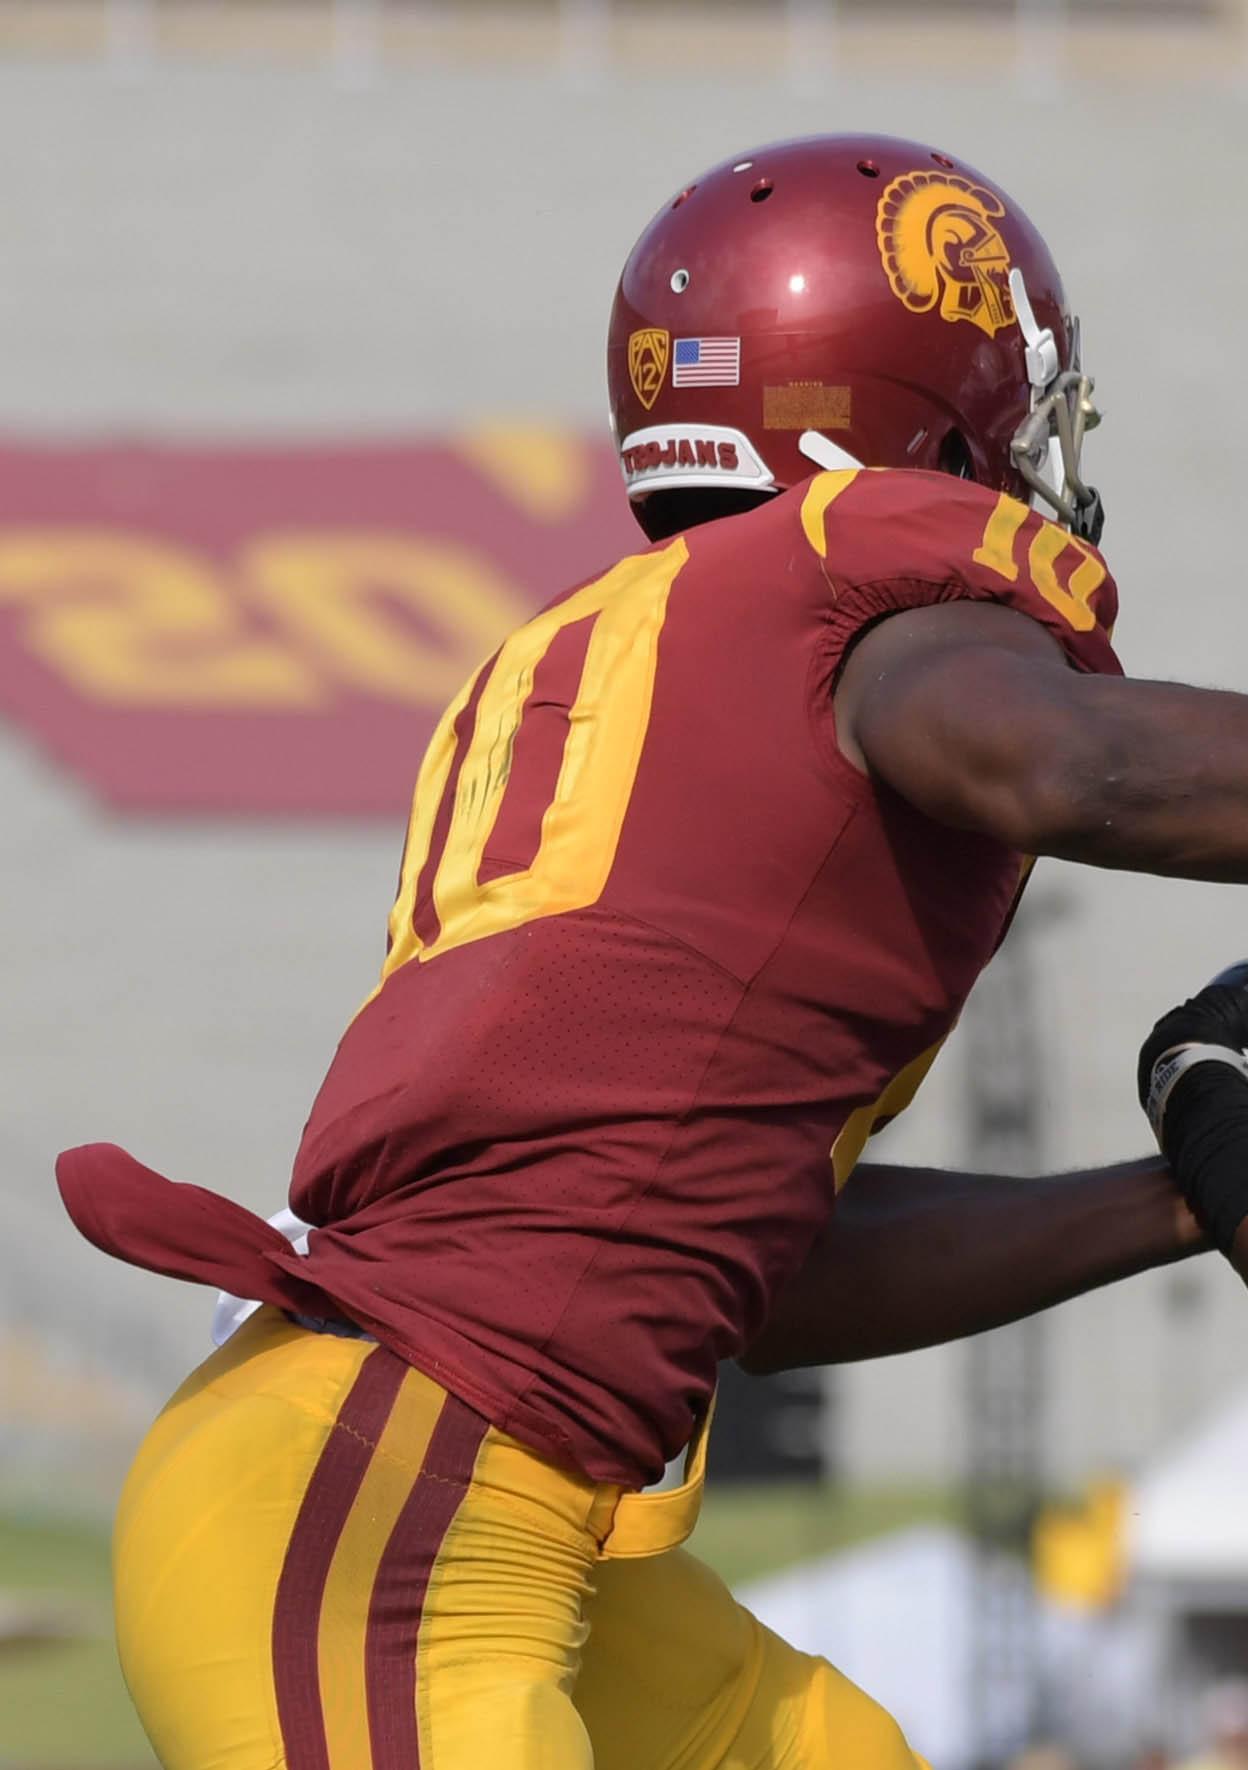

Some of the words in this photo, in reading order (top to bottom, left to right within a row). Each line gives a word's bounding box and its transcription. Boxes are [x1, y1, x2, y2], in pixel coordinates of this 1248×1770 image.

[632, 334, 665, 373] PAC
[638, 363, 659, 391] 12
[621, 440, 738, 474] TROJANS
[972, 492, 1106, 631] 10
